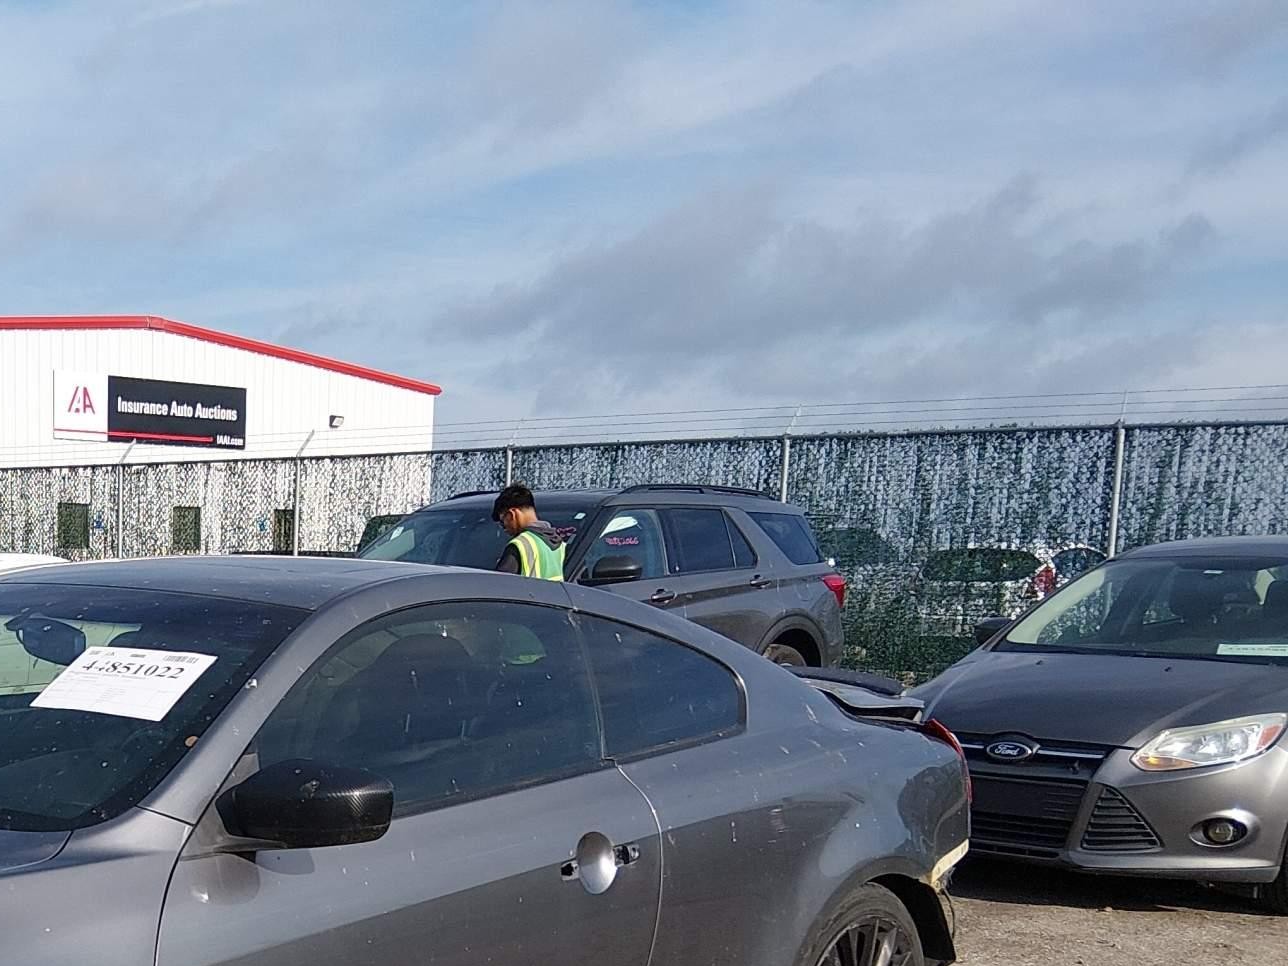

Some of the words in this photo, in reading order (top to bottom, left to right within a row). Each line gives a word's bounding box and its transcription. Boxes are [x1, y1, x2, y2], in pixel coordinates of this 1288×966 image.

[117, 396, 168, 416] Insurance
[170, 401, 194, 418] Auto
[195, 403, 238, 422] Auctions
[994, 744, 1021, 756] Ford
